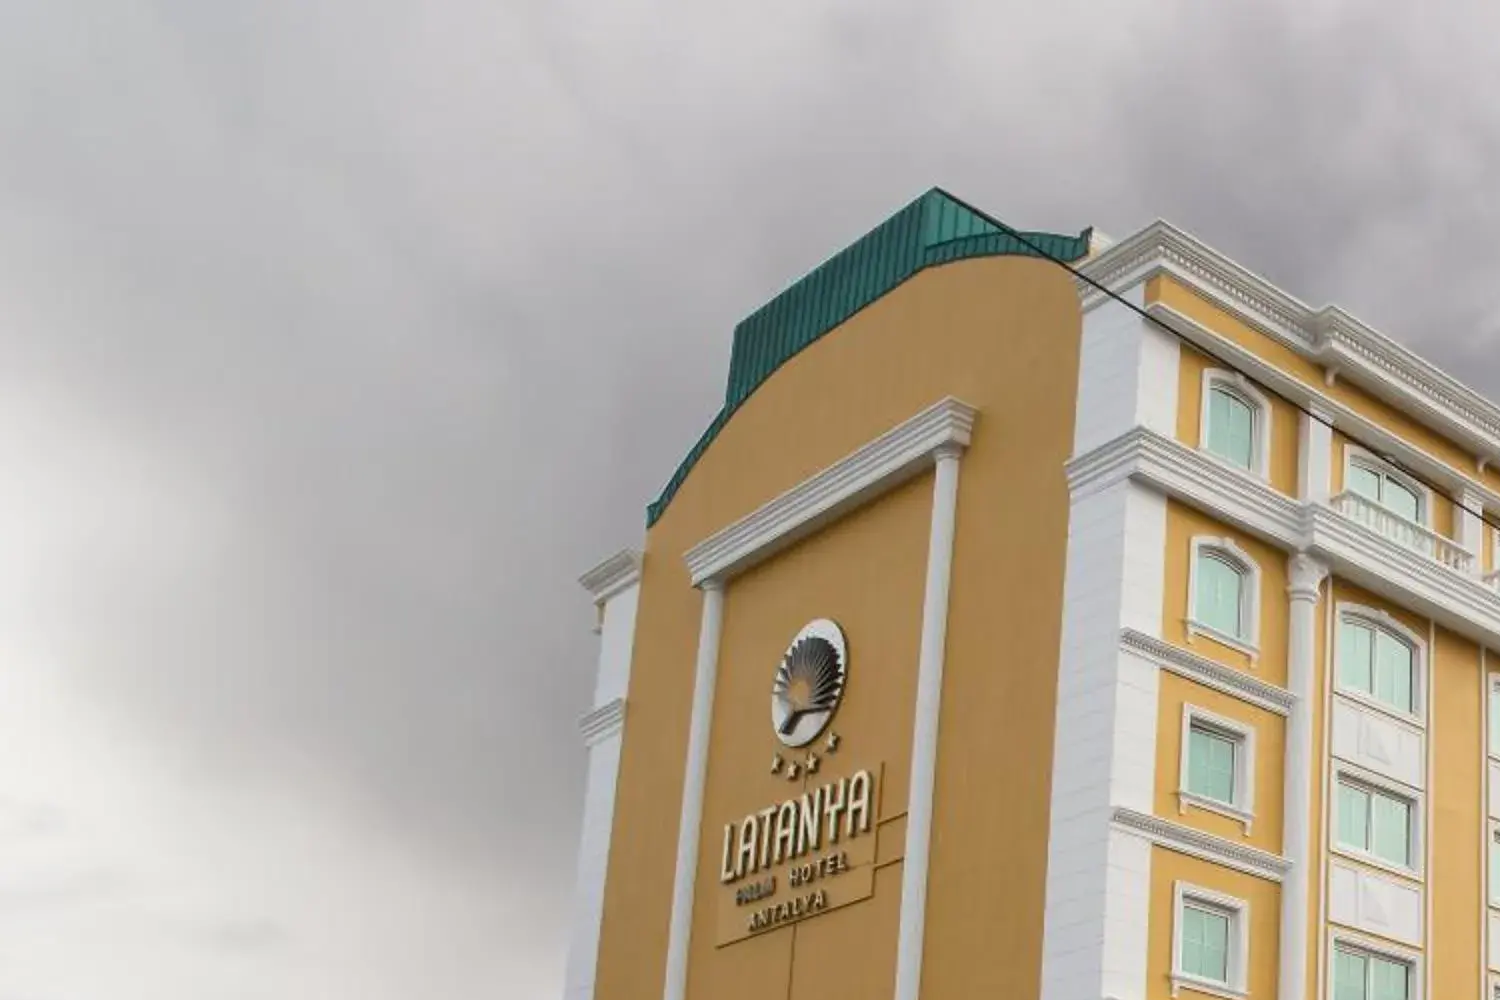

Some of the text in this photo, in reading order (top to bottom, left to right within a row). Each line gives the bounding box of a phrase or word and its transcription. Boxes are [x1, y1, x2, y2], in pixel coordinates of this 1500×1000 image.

[720, 769, 872, 882] LATANYA
[789, 852, 847, 887] HOTEL
[748, 890, 826, 930] ANTALYA
